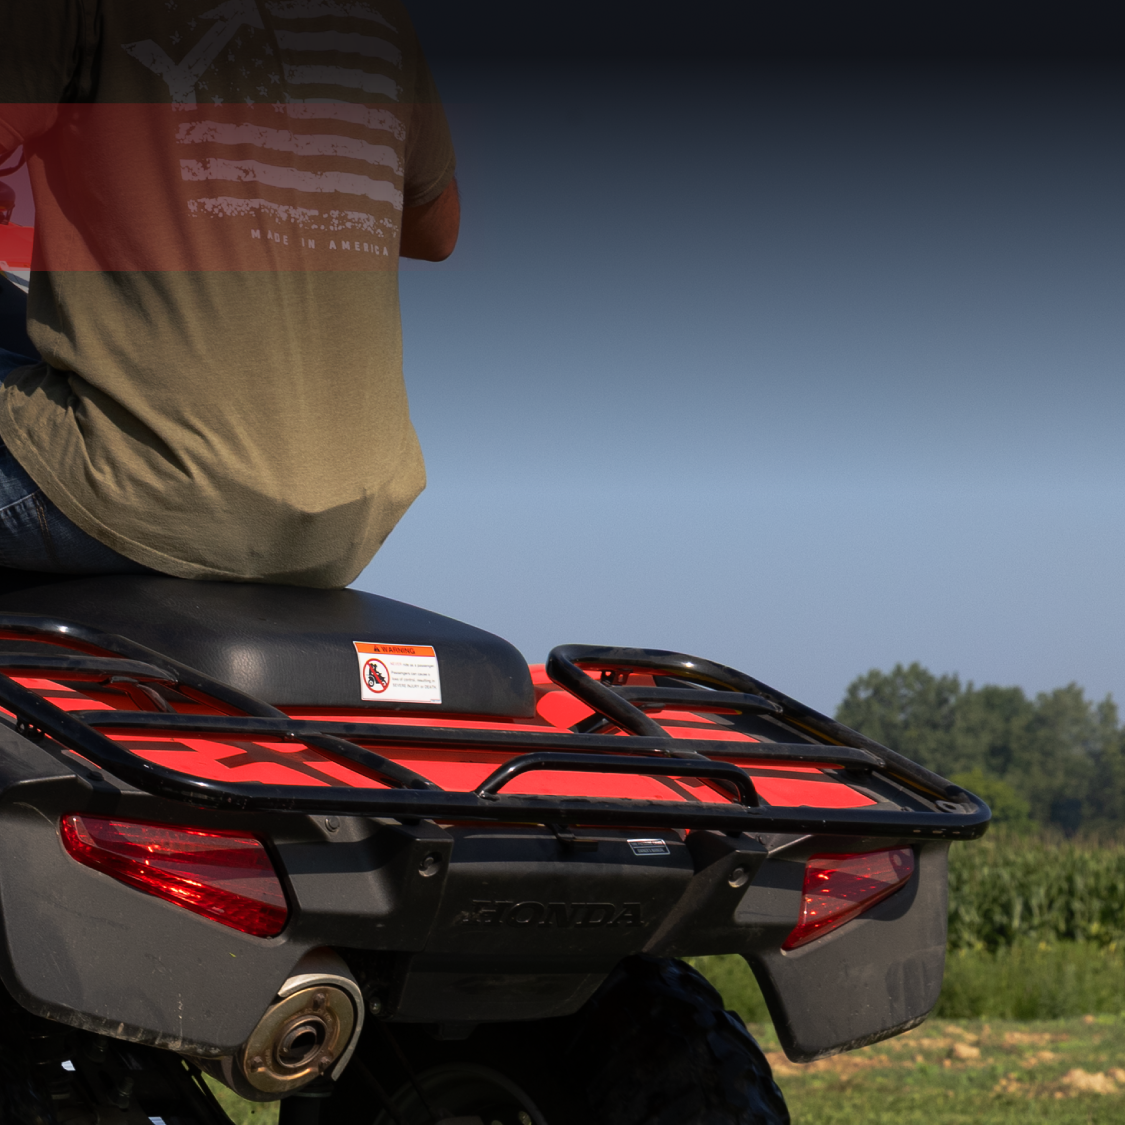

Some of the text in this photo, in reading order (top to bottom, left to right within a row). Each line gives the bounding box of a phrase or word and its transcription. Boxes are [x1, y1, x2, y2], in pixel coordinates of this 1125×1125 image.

[250, 228, 389, 256] MADE IN AMERICA
[380, 646, 416, 654] WARNING
[461, 898, 644, 928] HONDA
